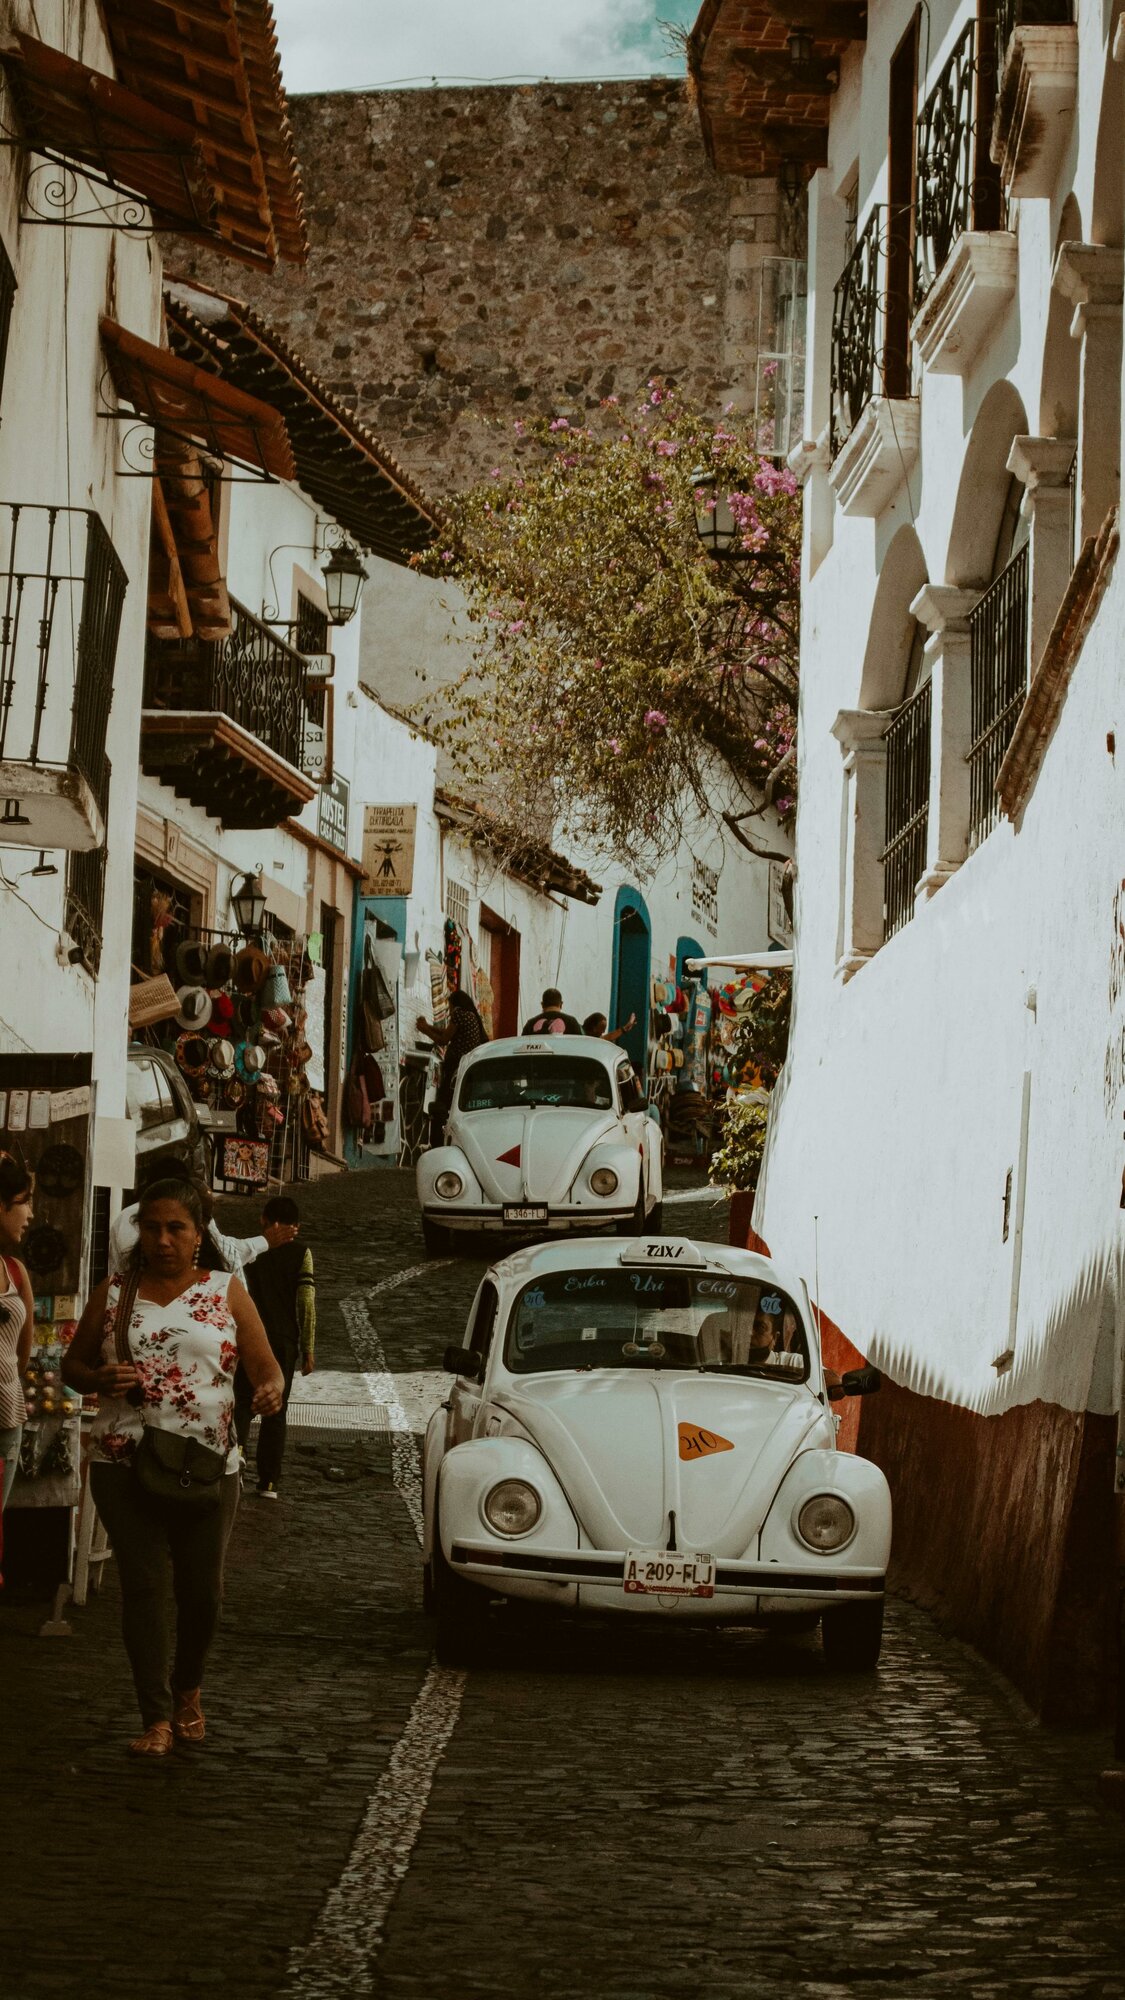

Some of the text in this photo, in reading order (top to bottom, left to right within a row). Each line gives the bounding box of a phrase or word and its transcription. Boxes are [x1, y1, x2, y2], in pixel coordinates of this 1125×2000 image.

[320, 791, 346, 832] HOSTEL
[468, 1099, 493, 1108] LIBRE
[504, 1208, 547, 1219] A-346-FLJ
[645, 1244, 684, 1258] TAXI
[564, 1274, 608, 1292] Erika
[629, 1273, 665, 1292] Uri
[680, 1430, 717, 1453] 40
[627, 1560, 712, 1585] A-209-FLJ
